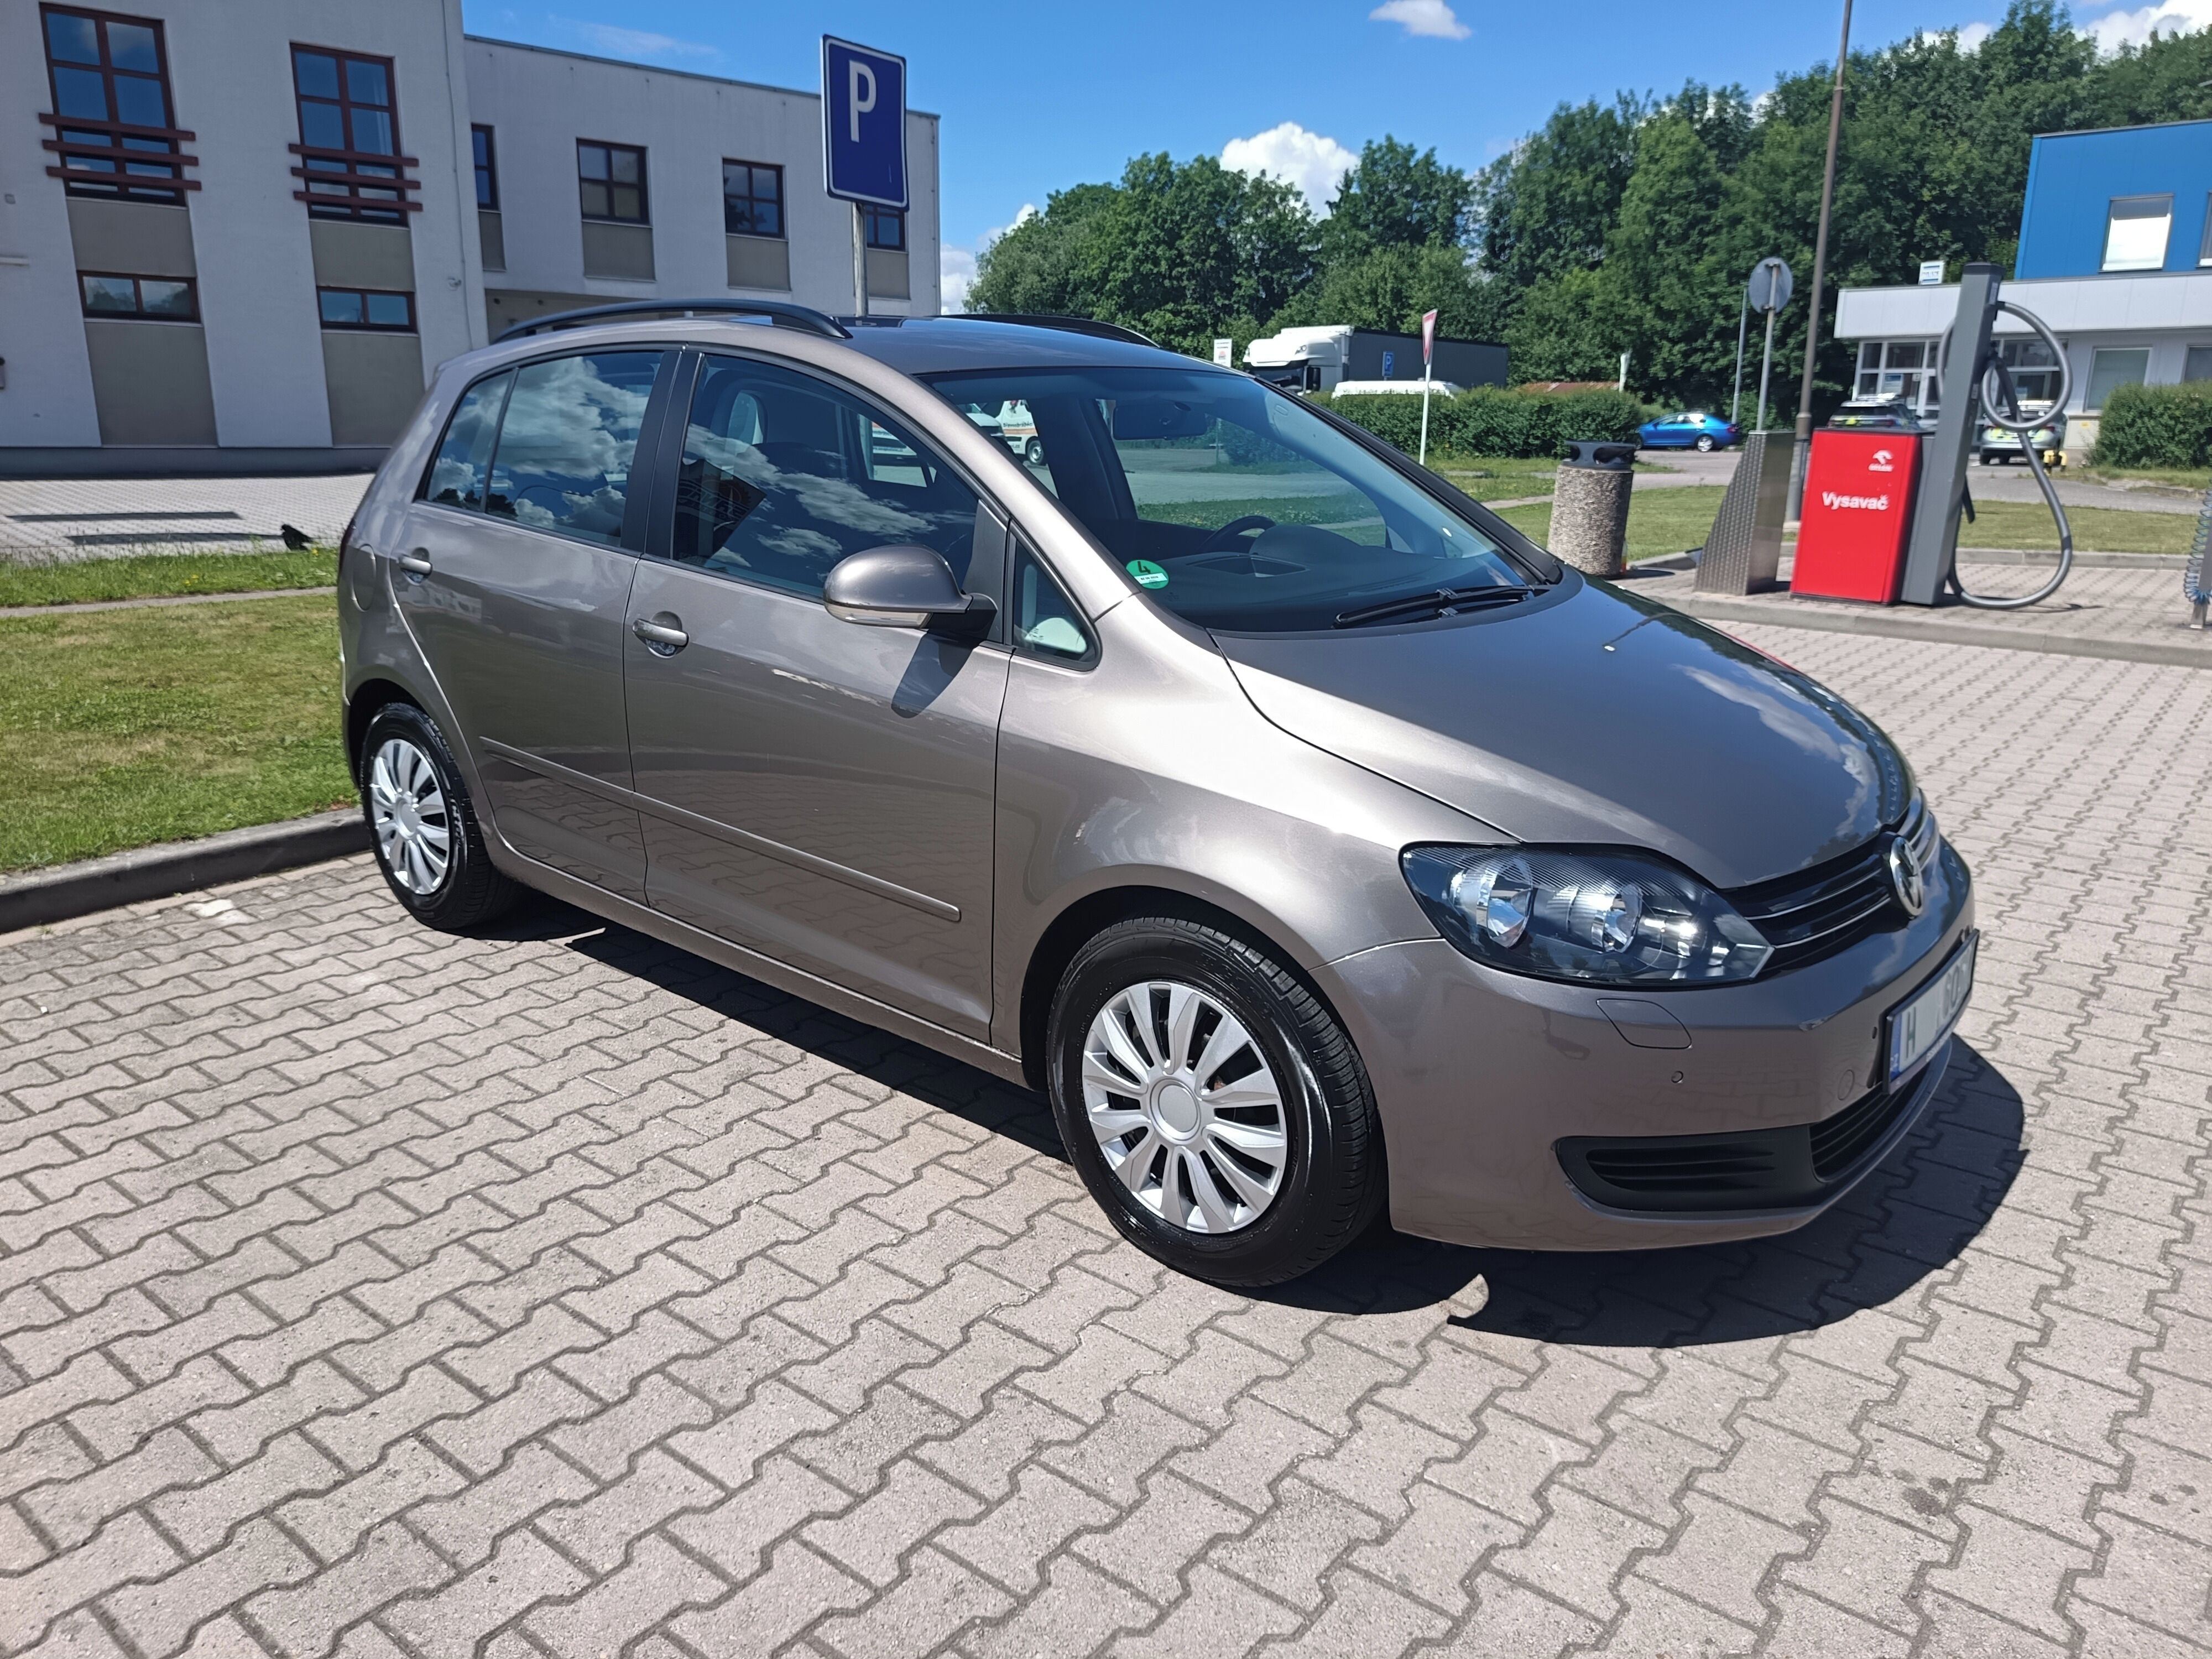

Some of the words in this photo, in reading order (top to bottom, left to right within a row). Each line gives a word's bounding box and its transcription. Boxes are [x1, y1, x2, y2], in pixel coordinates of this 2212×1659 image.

[849, 59, 877, 143] P
[1385, 355, 1391, 369] P
[1822, 491, 1889, 510] Vysavač
[1137, 561, 1151, 574] 4
